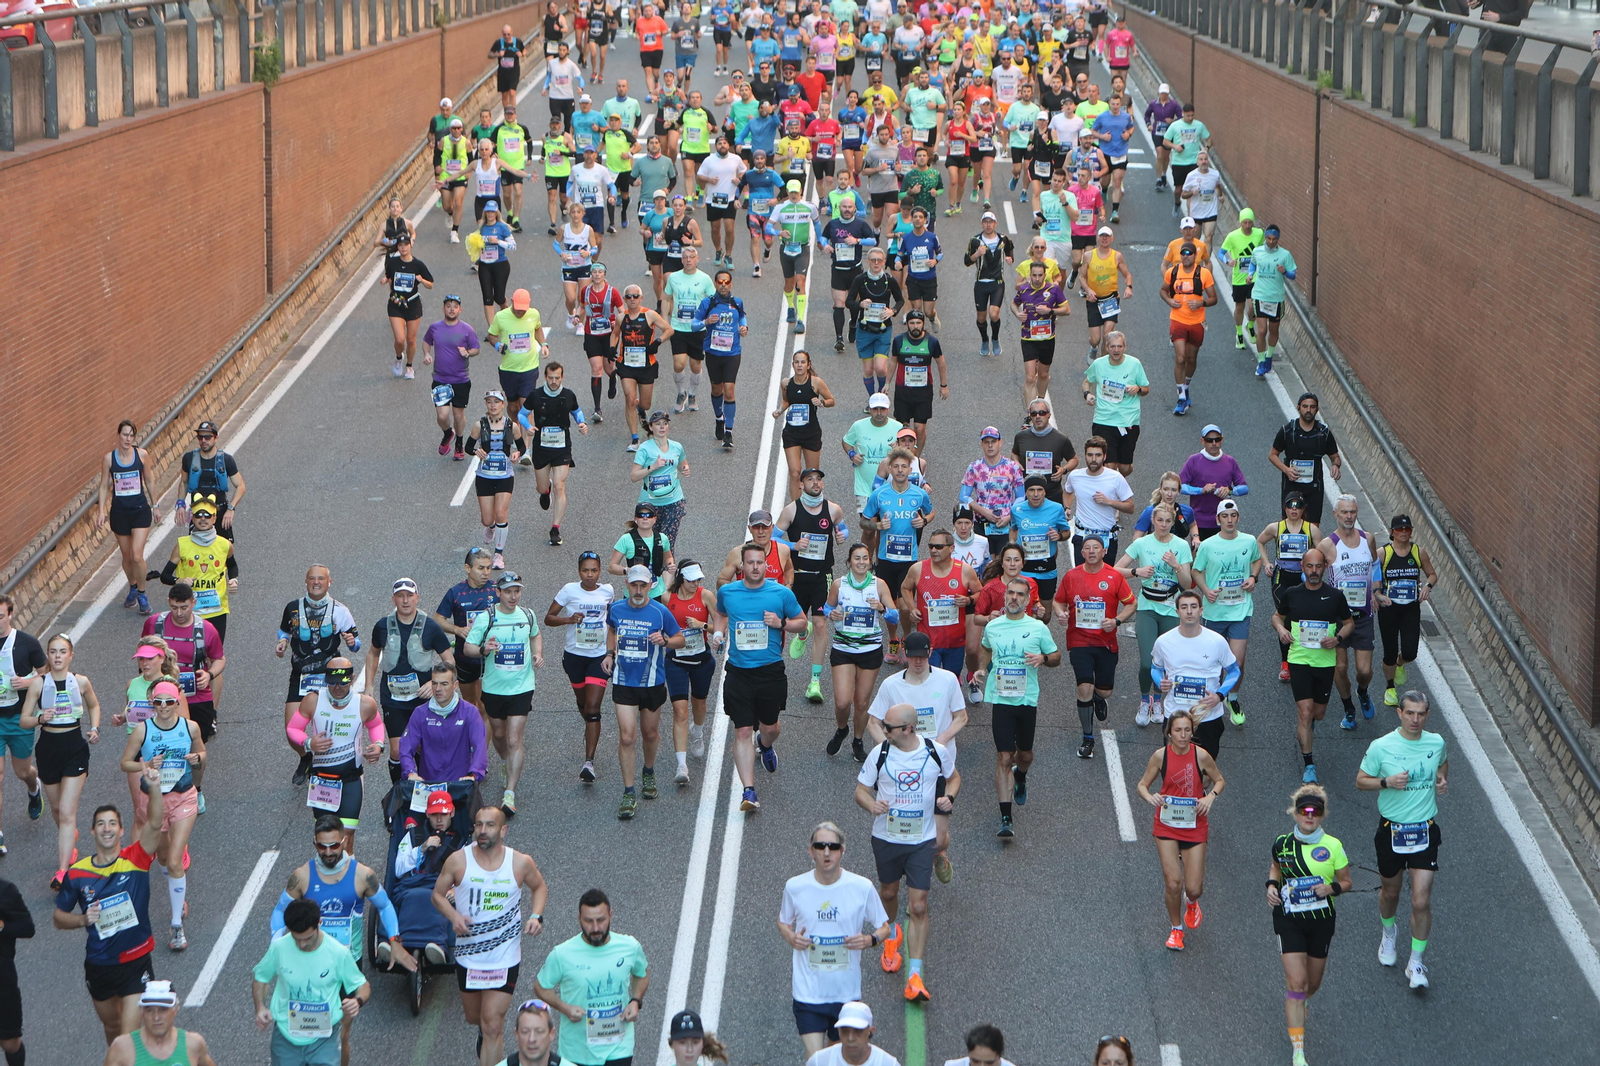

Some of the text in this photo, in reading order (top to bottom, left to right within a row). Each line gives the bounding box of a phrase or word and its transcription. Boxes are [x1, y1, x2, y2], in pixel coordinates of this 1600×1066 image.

[191, 579, 216, 589] JAPAN
[1299, 877, 1320, 885] ZURICH
[103, 896, 125, 907] ZURICH
[302, 1004, 326, 1012] ZURICH
